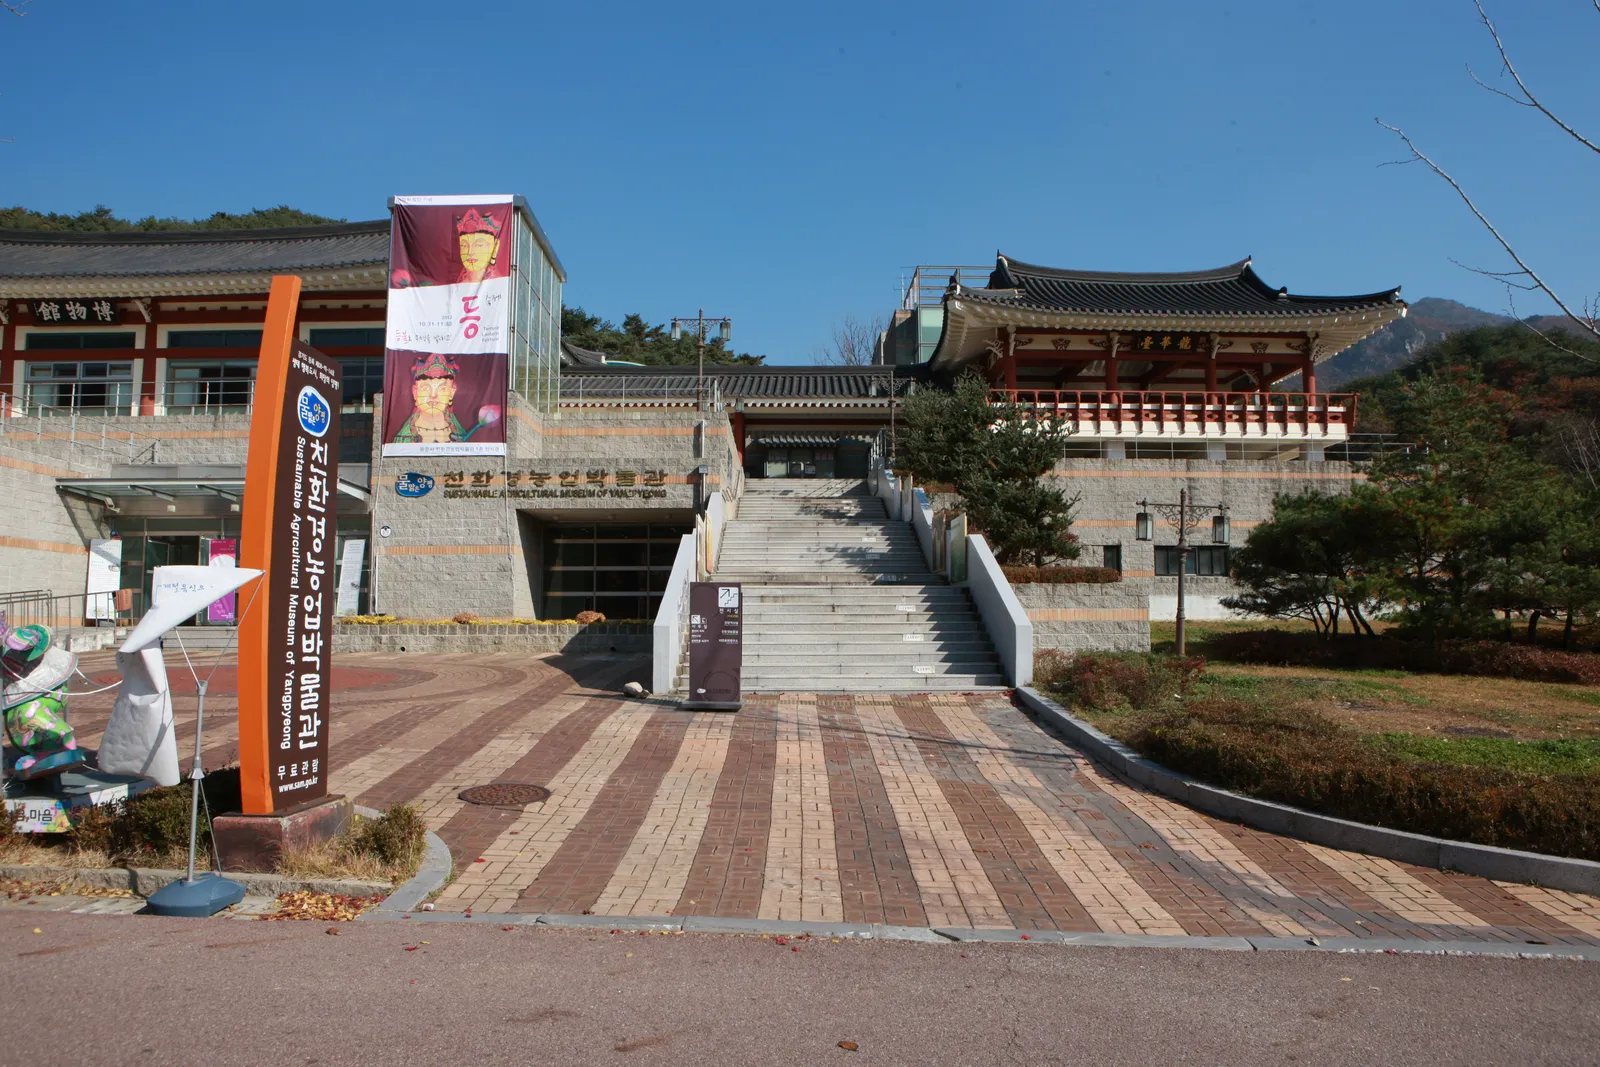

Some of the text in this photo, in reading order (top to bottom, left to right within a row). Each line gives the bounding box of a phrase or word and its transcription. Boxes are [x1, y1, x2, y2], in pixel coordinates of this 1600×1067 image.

[443, 489, 498, 499] SUSTAINABLE
[560, 489, 596, 498] MUSEUM
[597, 489, 608, 498] OF
[609, 489, 667, 499] YANGPYEONG
[280, 435, 306, 750] Sustainable Agricultural Museum of Yangpyeong
[298, 439, 329, 750] 친환경농업박물관
[277, 758, 319, 780] 무료관람
